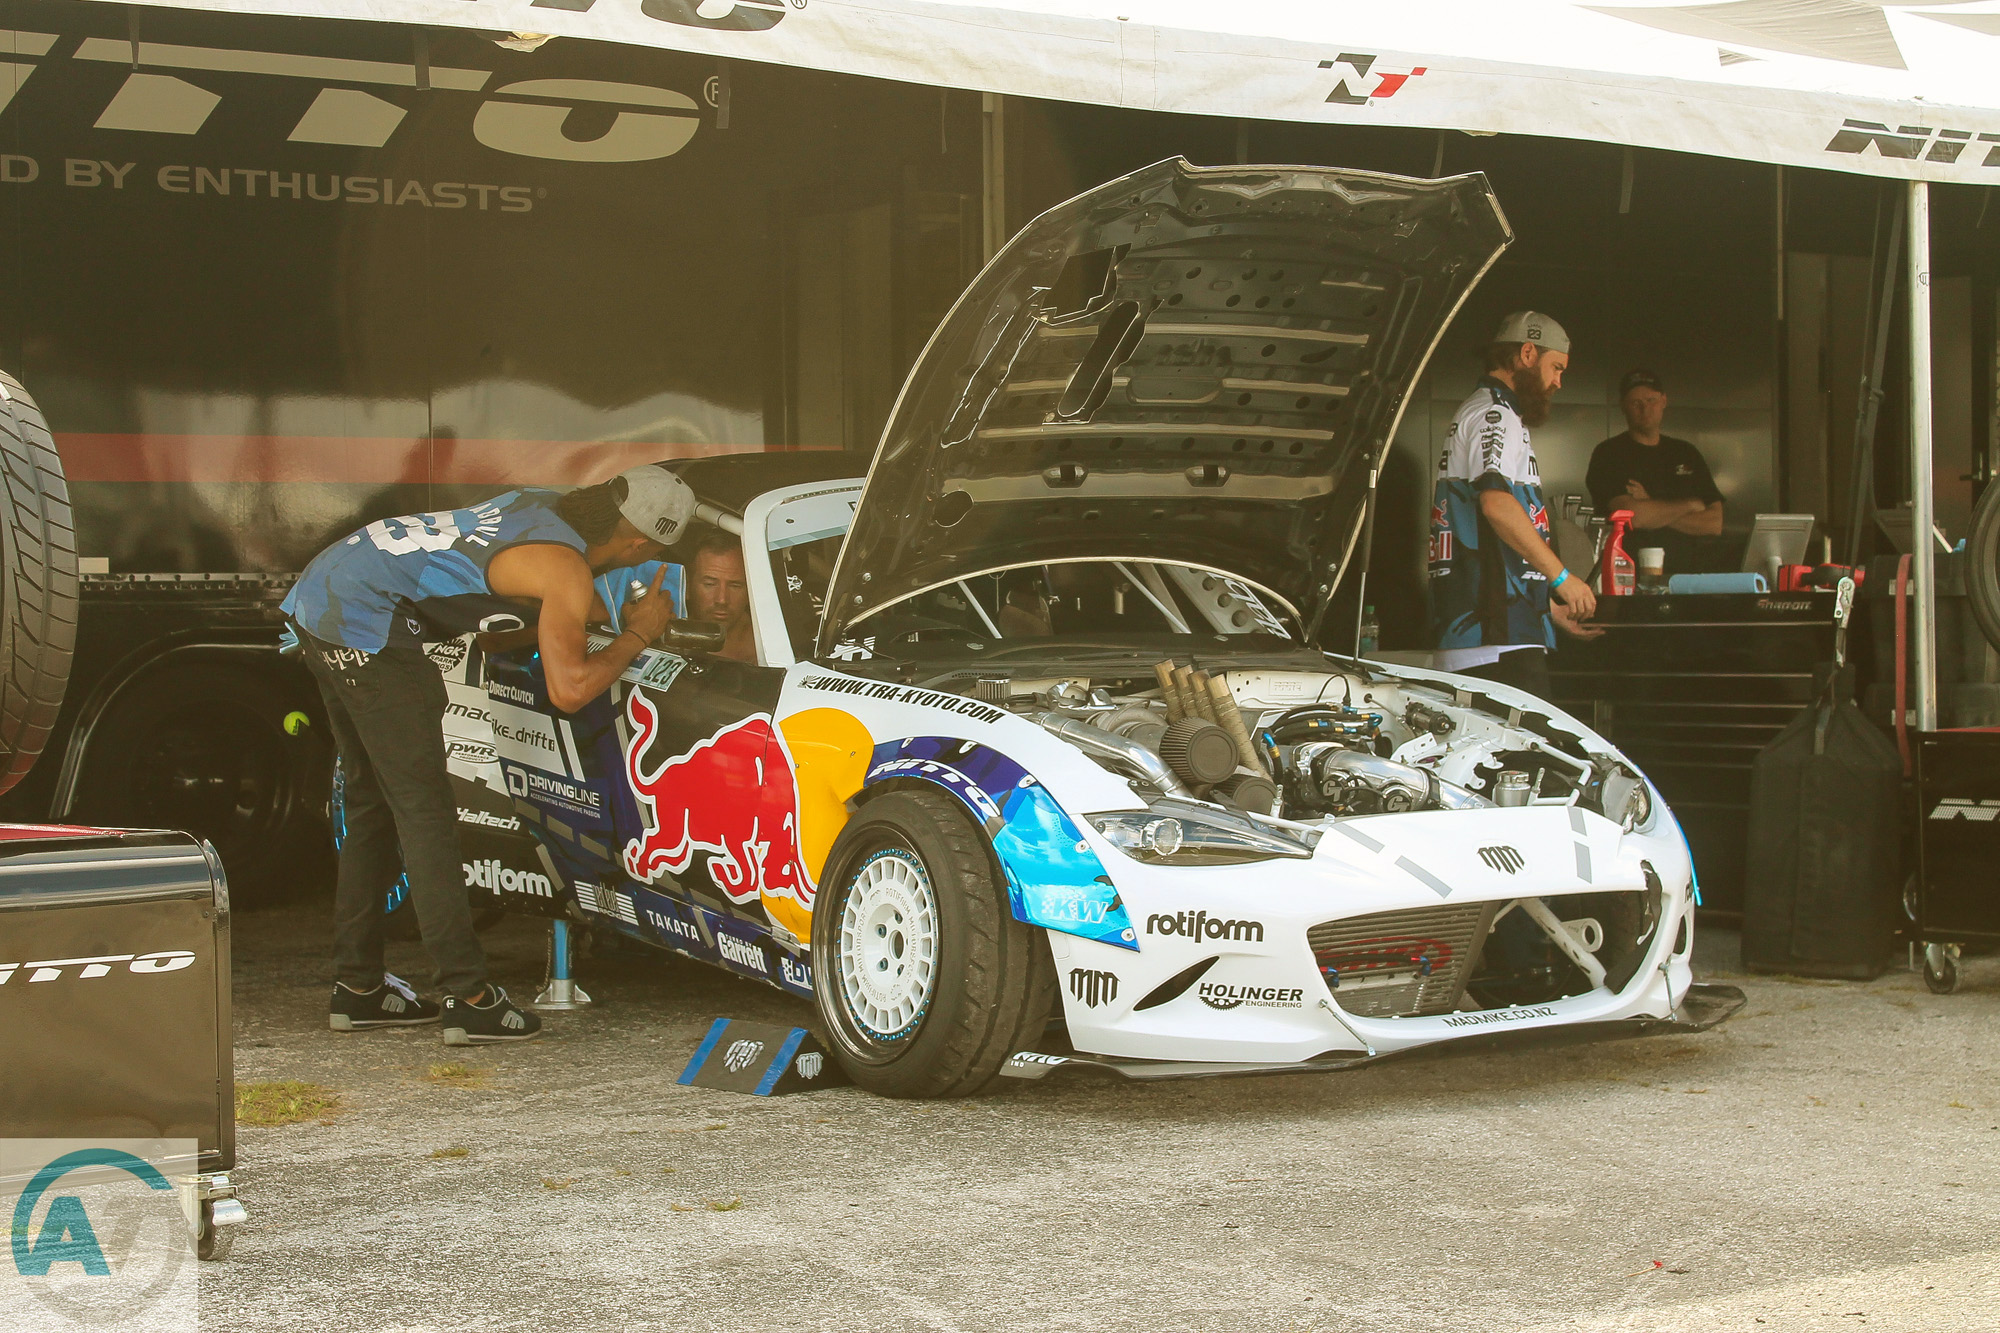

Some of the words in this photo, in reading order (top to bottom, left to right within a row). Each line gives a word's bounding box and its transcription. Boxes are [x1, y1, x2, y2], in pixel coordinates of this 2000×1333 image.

[0, 30, 699, 162] TTO
[65, 158, 137, 188] BY
[157, 164, 533, 212] ENTHUSIASTS
[434, 645, 463, 657] NGK
[643, 657, 682, 684] 123
[489, 680, 510, 698] DIRECT
[511, 686, 534, 705] CLUTCH
[814, 676, 1005, 724] WWW.TRA-KYOTO.COM
[446, 743, 498, 758] PWR
[868, 758, 1000, 817] NITTO
[646, 909, 700, 942] TAKATA
[1147, 910, 1264, 943] rotiform
[717, 931, 768, 974] Garrett
[1198, 982, 1303, 1001] HOLINGER
[1246, 1000, 1302, 1009] ENGINEERING
[1442, 1006, 1558, 1028] MADMIKE.CO.NZ
